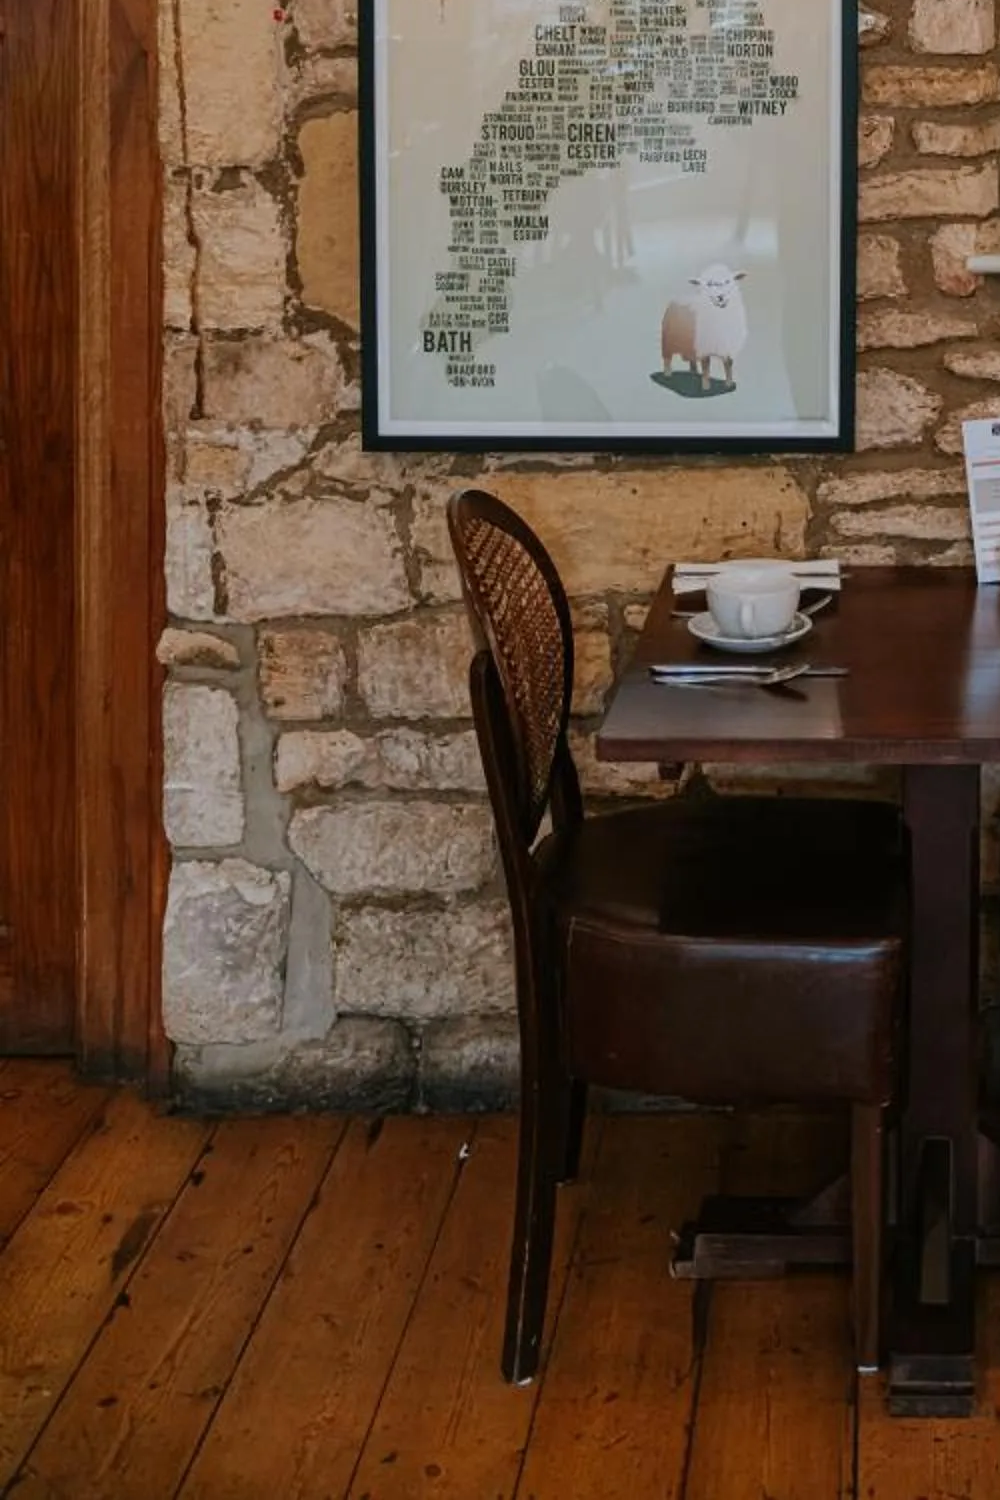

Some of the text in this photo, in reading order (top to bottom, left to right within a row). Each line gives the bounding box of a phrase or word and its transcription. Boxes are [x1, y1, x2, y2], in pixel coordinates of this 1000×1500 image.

[535, 24, 577, 41] CHELT
[726, 29, 775, 42] CHIPPING
[535, 44, 577, 56] ENHAM
[727, 44, 774, 57] NORTON
[519, 59, 555, 76] GLOU
[518, 78, 555, 88] CESTER
[737, 100, 787, 115] WITNEY
[481, 125, 535, 141] STROUD
[567, 123, 616, 142] CIREN
[567, 144, 616, 159] CESTER
[683, 148, 707, 160] LECH
[441, 166, 465, 179] CAM
[489, 160, 523, 172] NAILS
[440, 181, 487, 194] DURSLEY
[503, 189, 549, 202] TETBURY
[513, 215, 549, 228] MALM
[423, 330, 473, 353] BATH
